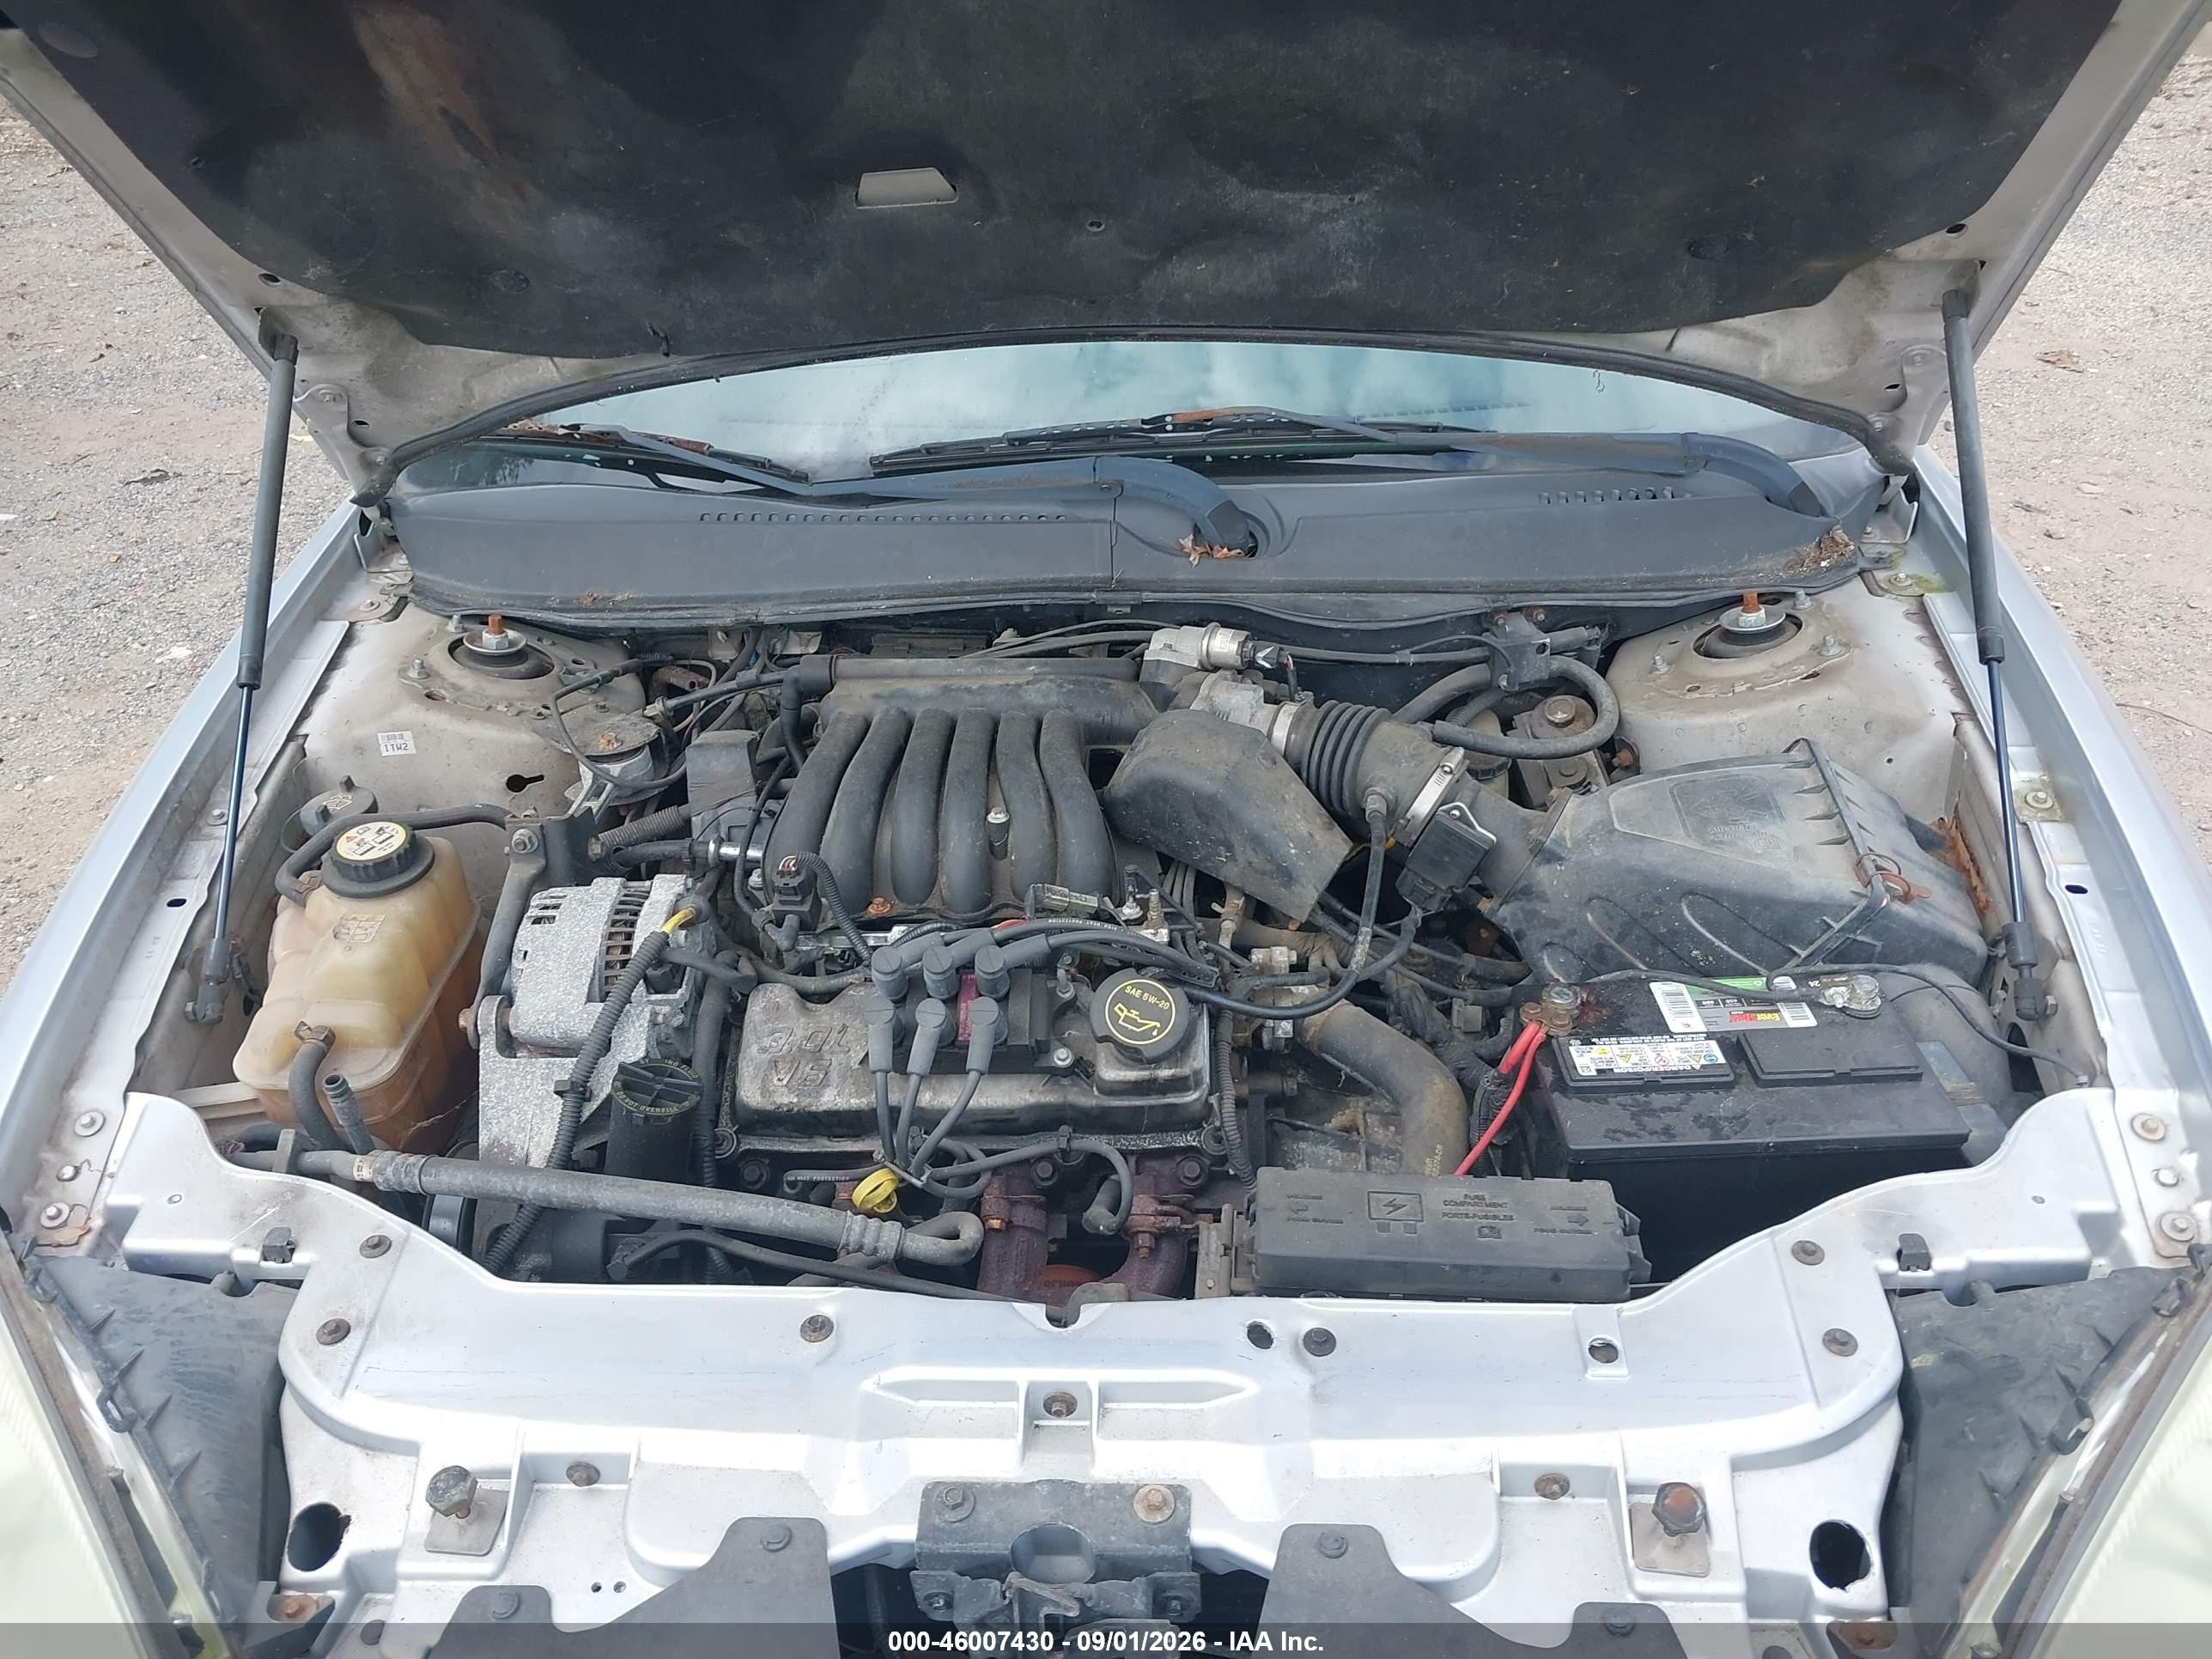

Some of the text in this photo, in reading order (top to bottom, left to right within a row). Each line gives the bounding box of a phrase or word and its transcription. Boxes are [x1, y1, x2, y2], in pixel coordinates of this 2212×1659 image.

[1125, 985, 1142, 999] SAE
[768, 1057, 834, 1088] V6
[639, 1104, 680, 1115] OVERFILL
